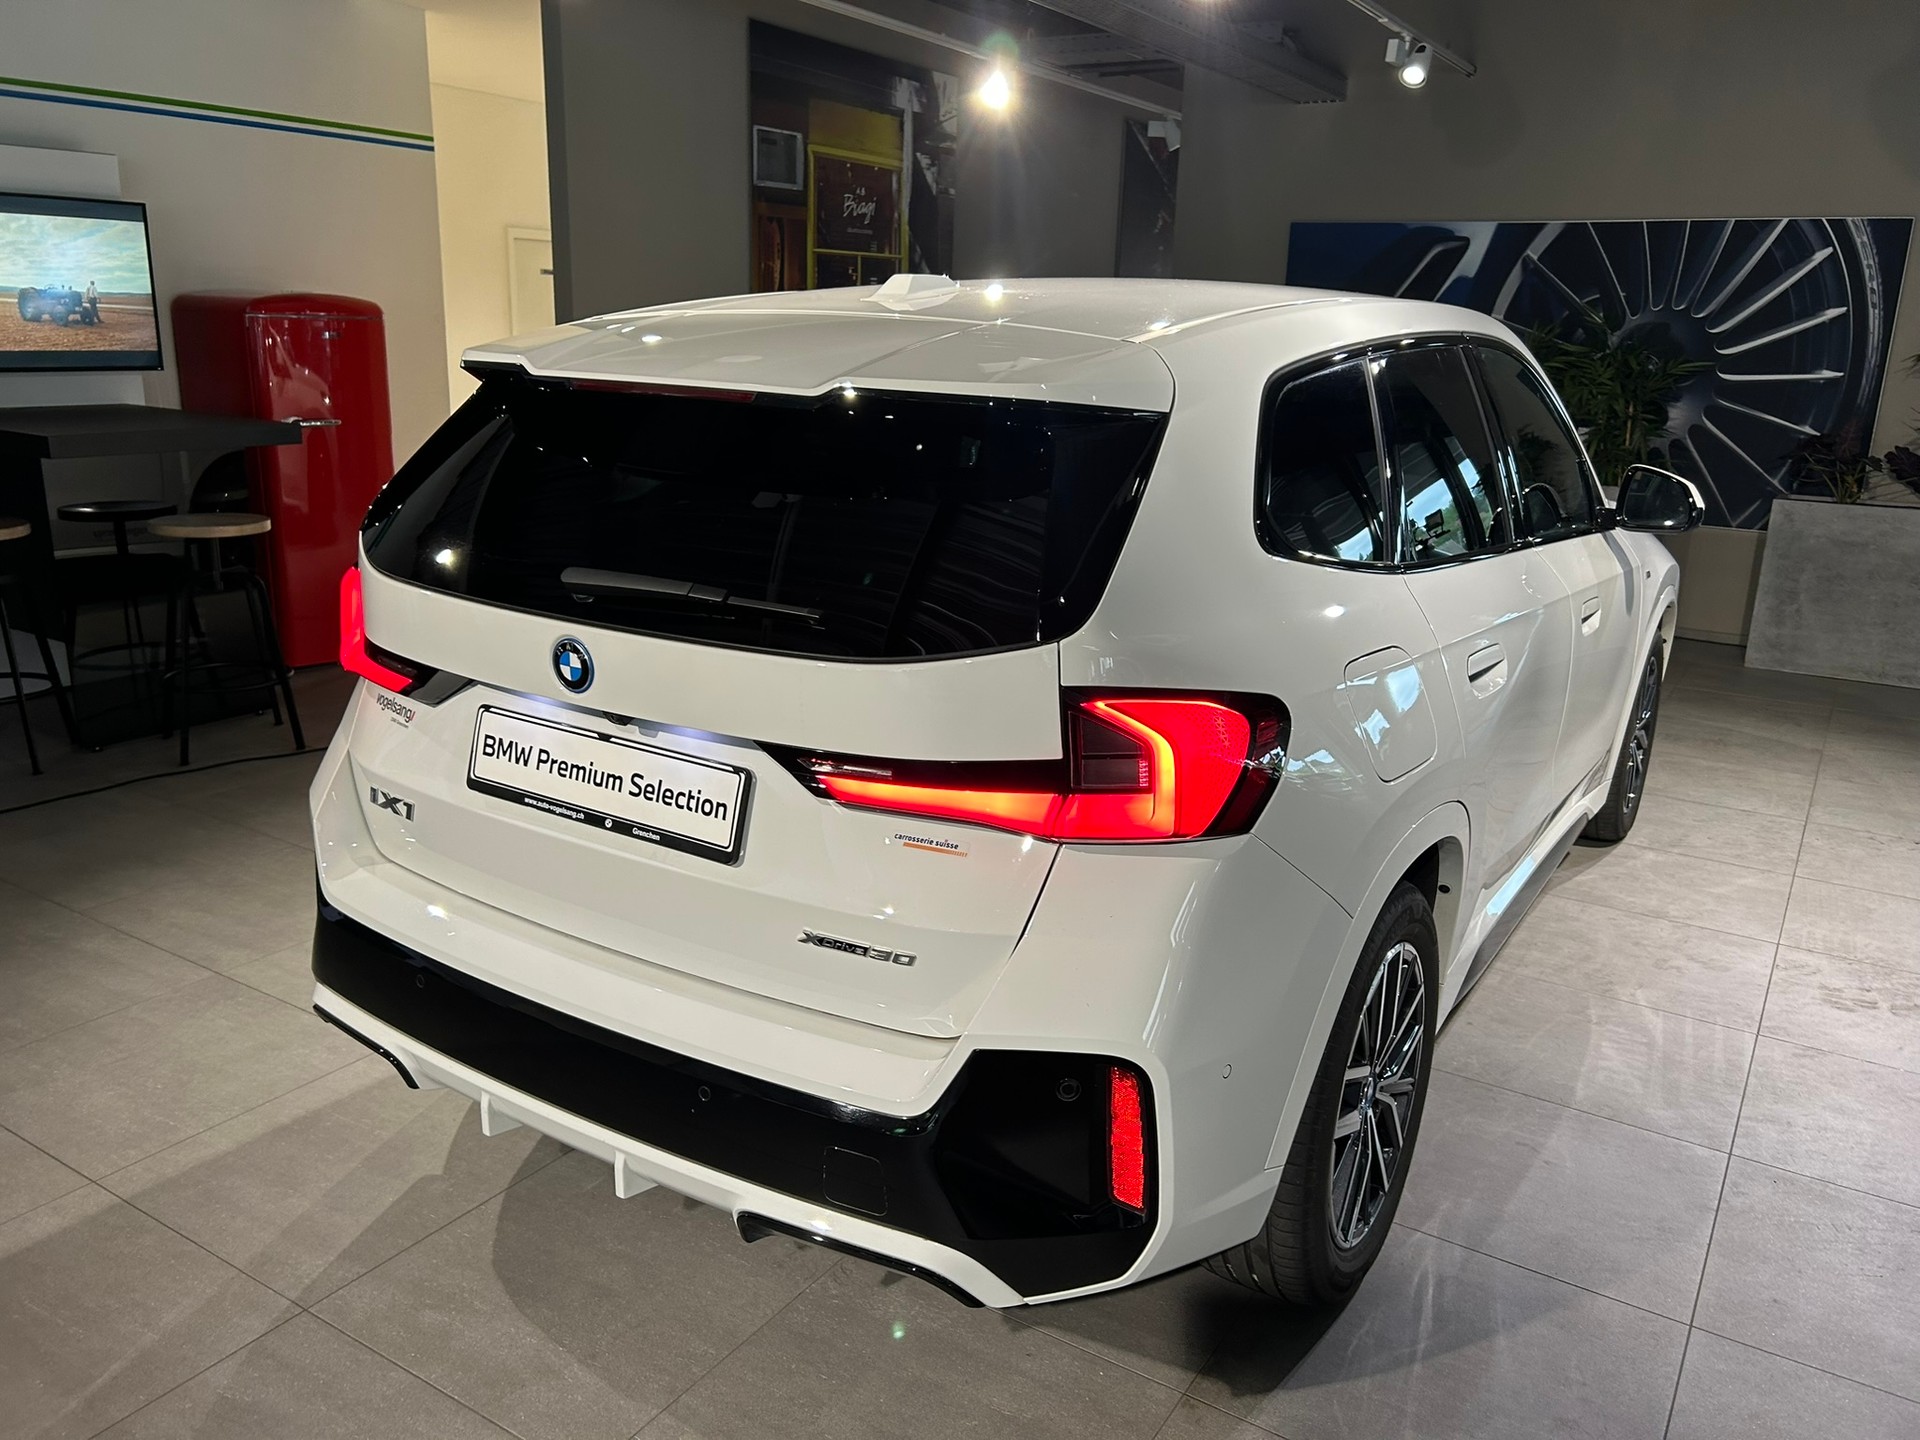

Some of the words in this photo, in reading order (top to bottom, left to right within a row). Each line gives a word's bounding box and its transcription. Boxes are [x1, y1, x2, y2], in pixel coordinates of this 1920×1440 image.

[482, 733, 533, 767] BMW
[536, 748, 623, 792] Premium
[628, 773, 728, 821] Selection
[894, 833, 934, 845] carrosserie
[935, 839, 959, 850] suisse
